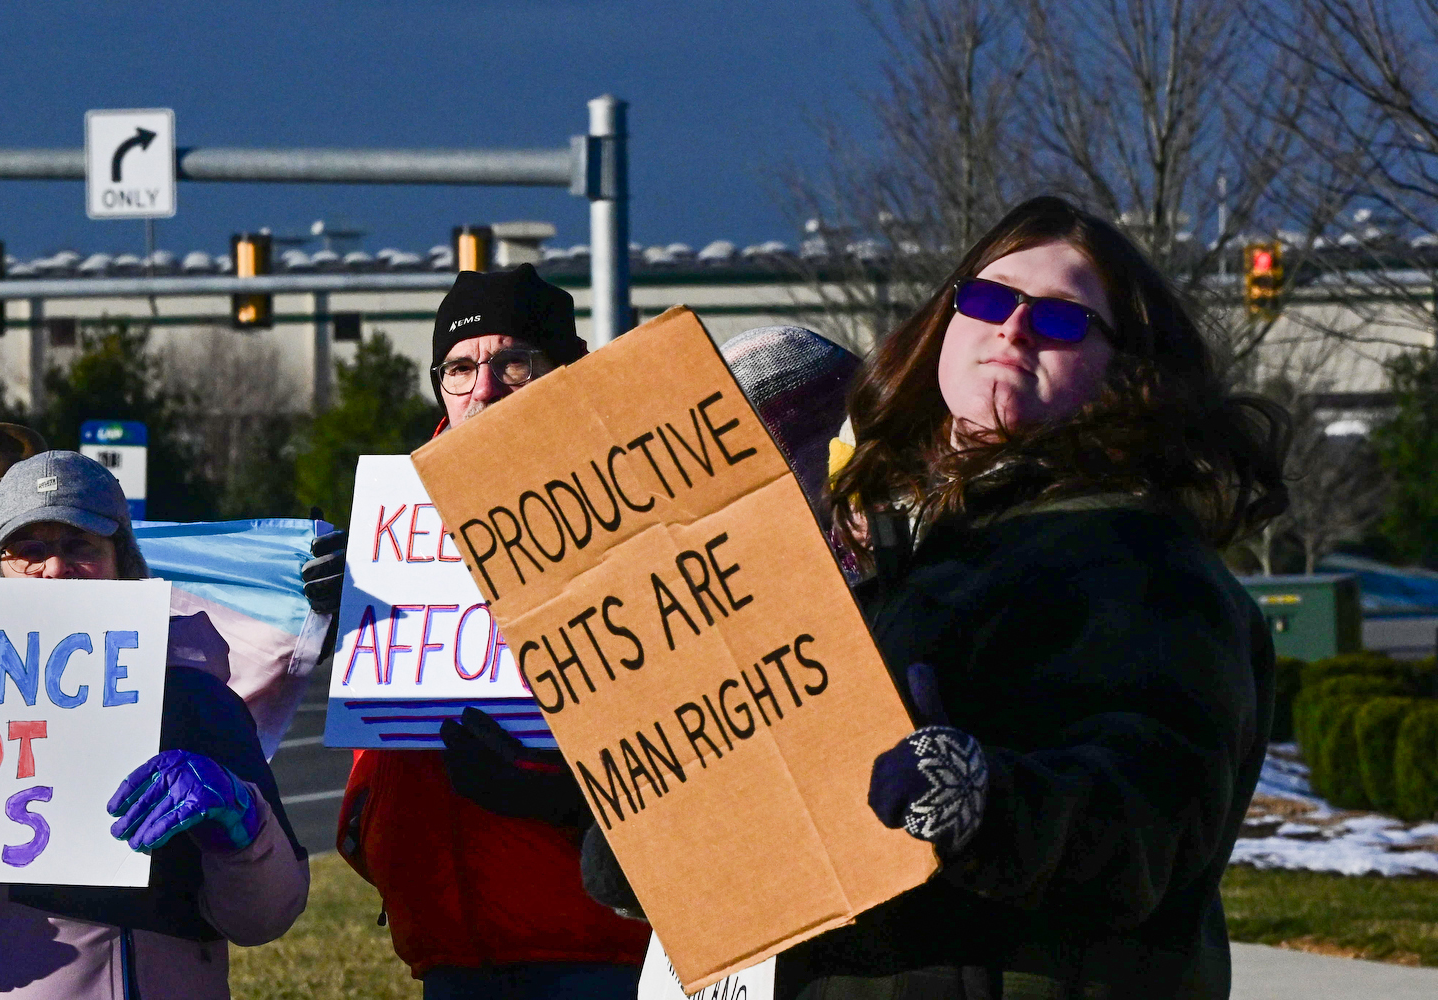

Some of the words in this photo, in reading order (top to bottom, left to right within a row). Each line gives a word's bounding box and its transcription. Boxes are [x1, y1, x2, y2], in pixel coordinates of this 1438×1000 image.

[102, 188, 159, 209] ONLY
[457, 314, 482, 327] EMS
[372, 503, 462, 563] KEE
[450, 391, 758, 606] PRODUCTIVE
[518, 595, 646, 716] GHTS
[650, 532, 754, 651] ARE
[577, 731, 687, 831] MAN
[684, 633, 829, 770] RIGHTS
